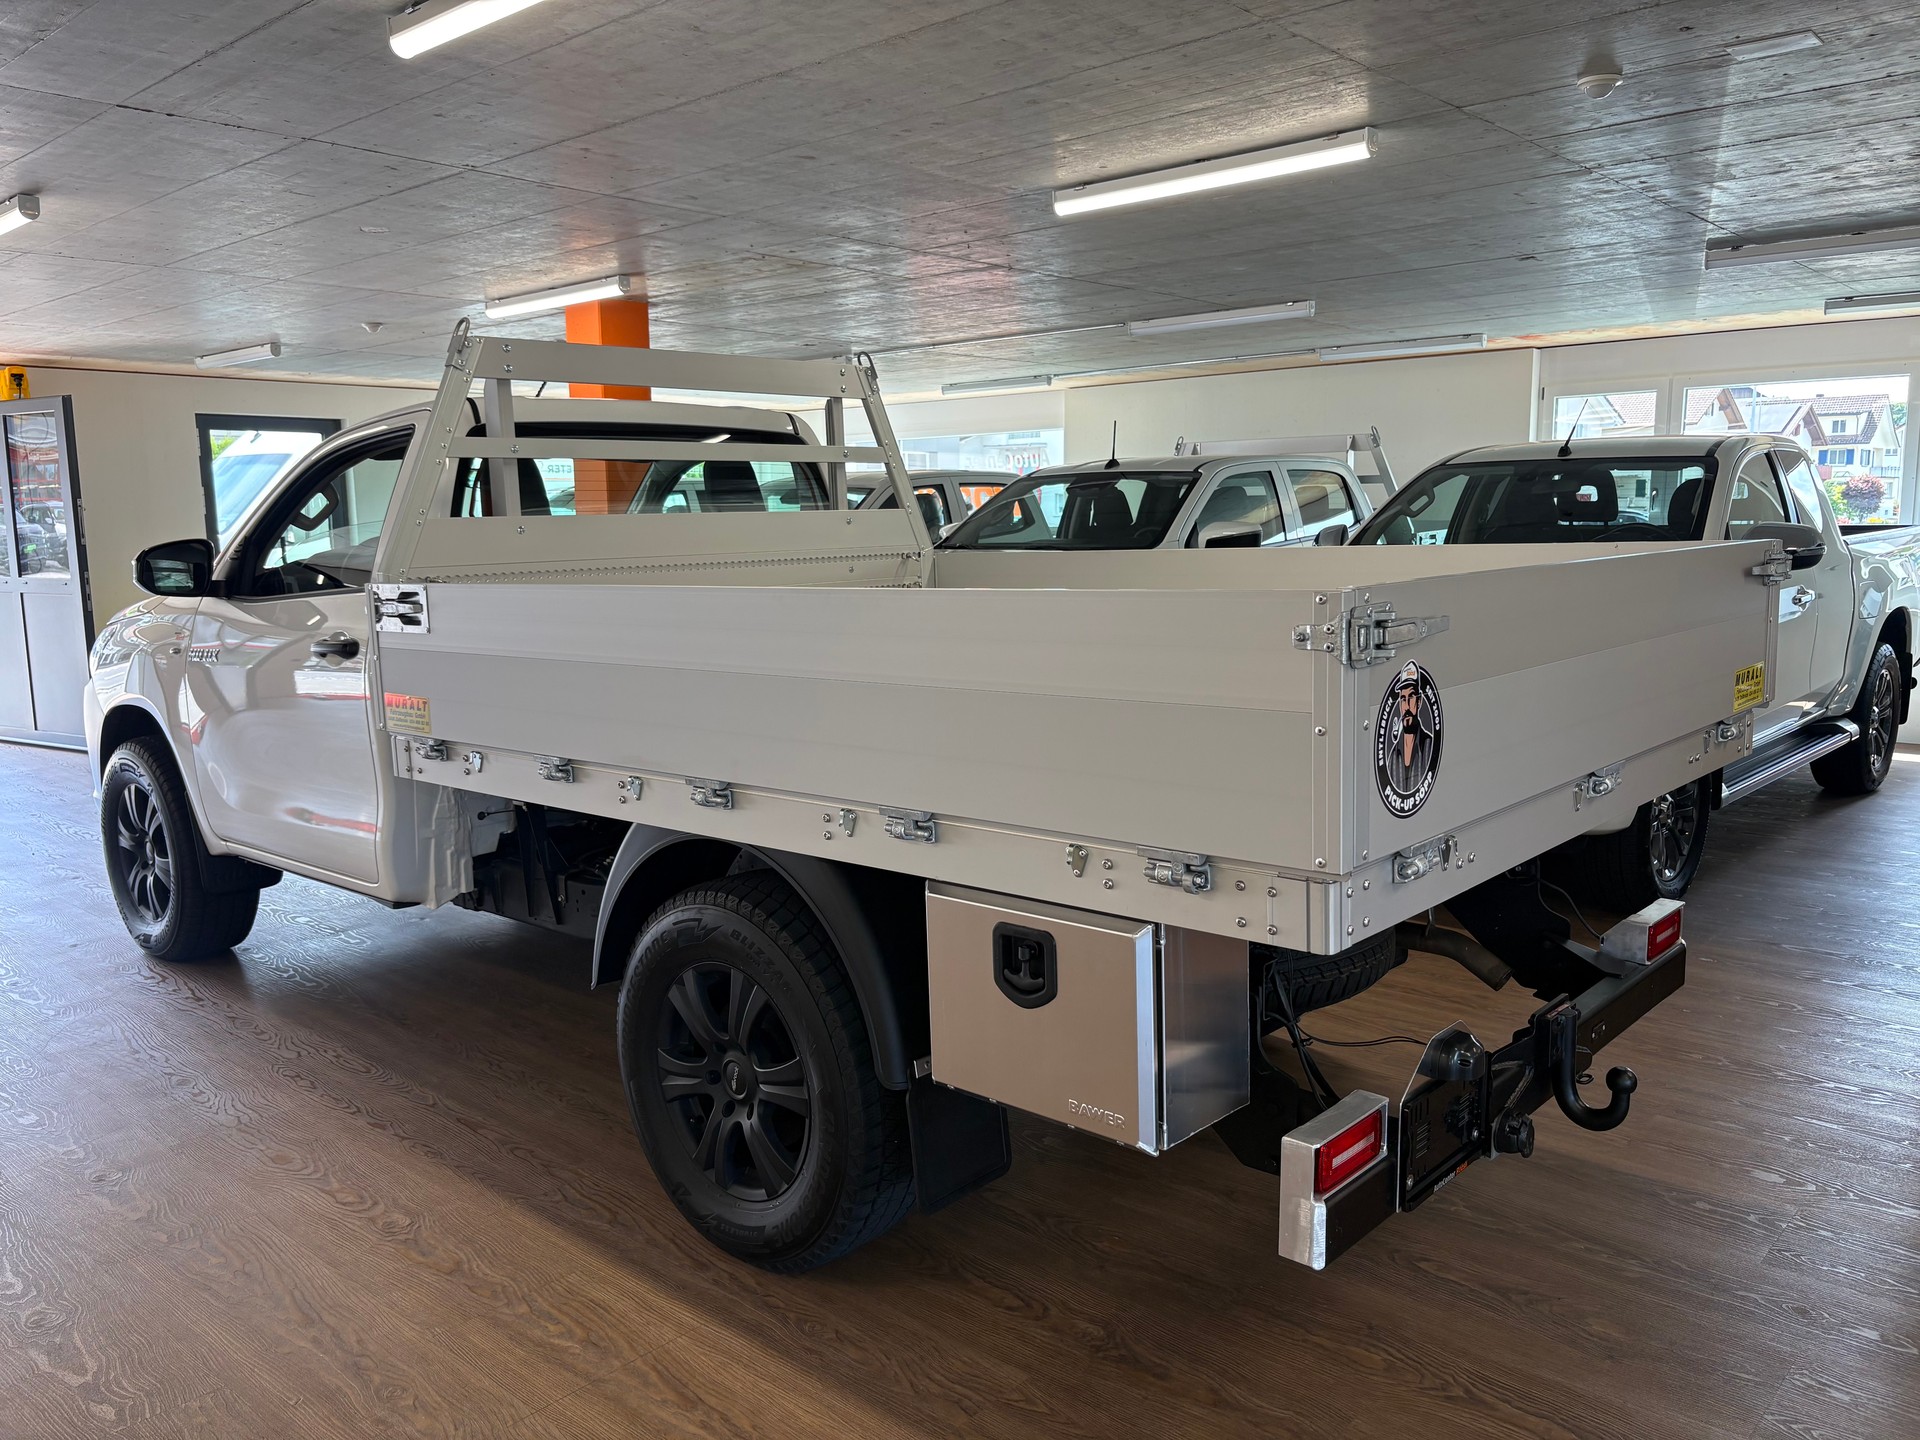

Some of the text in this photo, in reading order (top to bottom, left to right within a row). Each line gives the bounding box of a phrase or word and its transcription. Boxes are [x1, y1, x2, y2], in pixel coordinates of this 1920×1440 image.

[386, 696, 428, 712] MURALT
[1425, 685, 1435, 704] SEIT
[1379, 696, 1393, 767] ENTLEBUCH
[1384, 771, 1434, 811] PICK-UP SÖPP
[1068, 1098, 1125, 1130] BAWER
